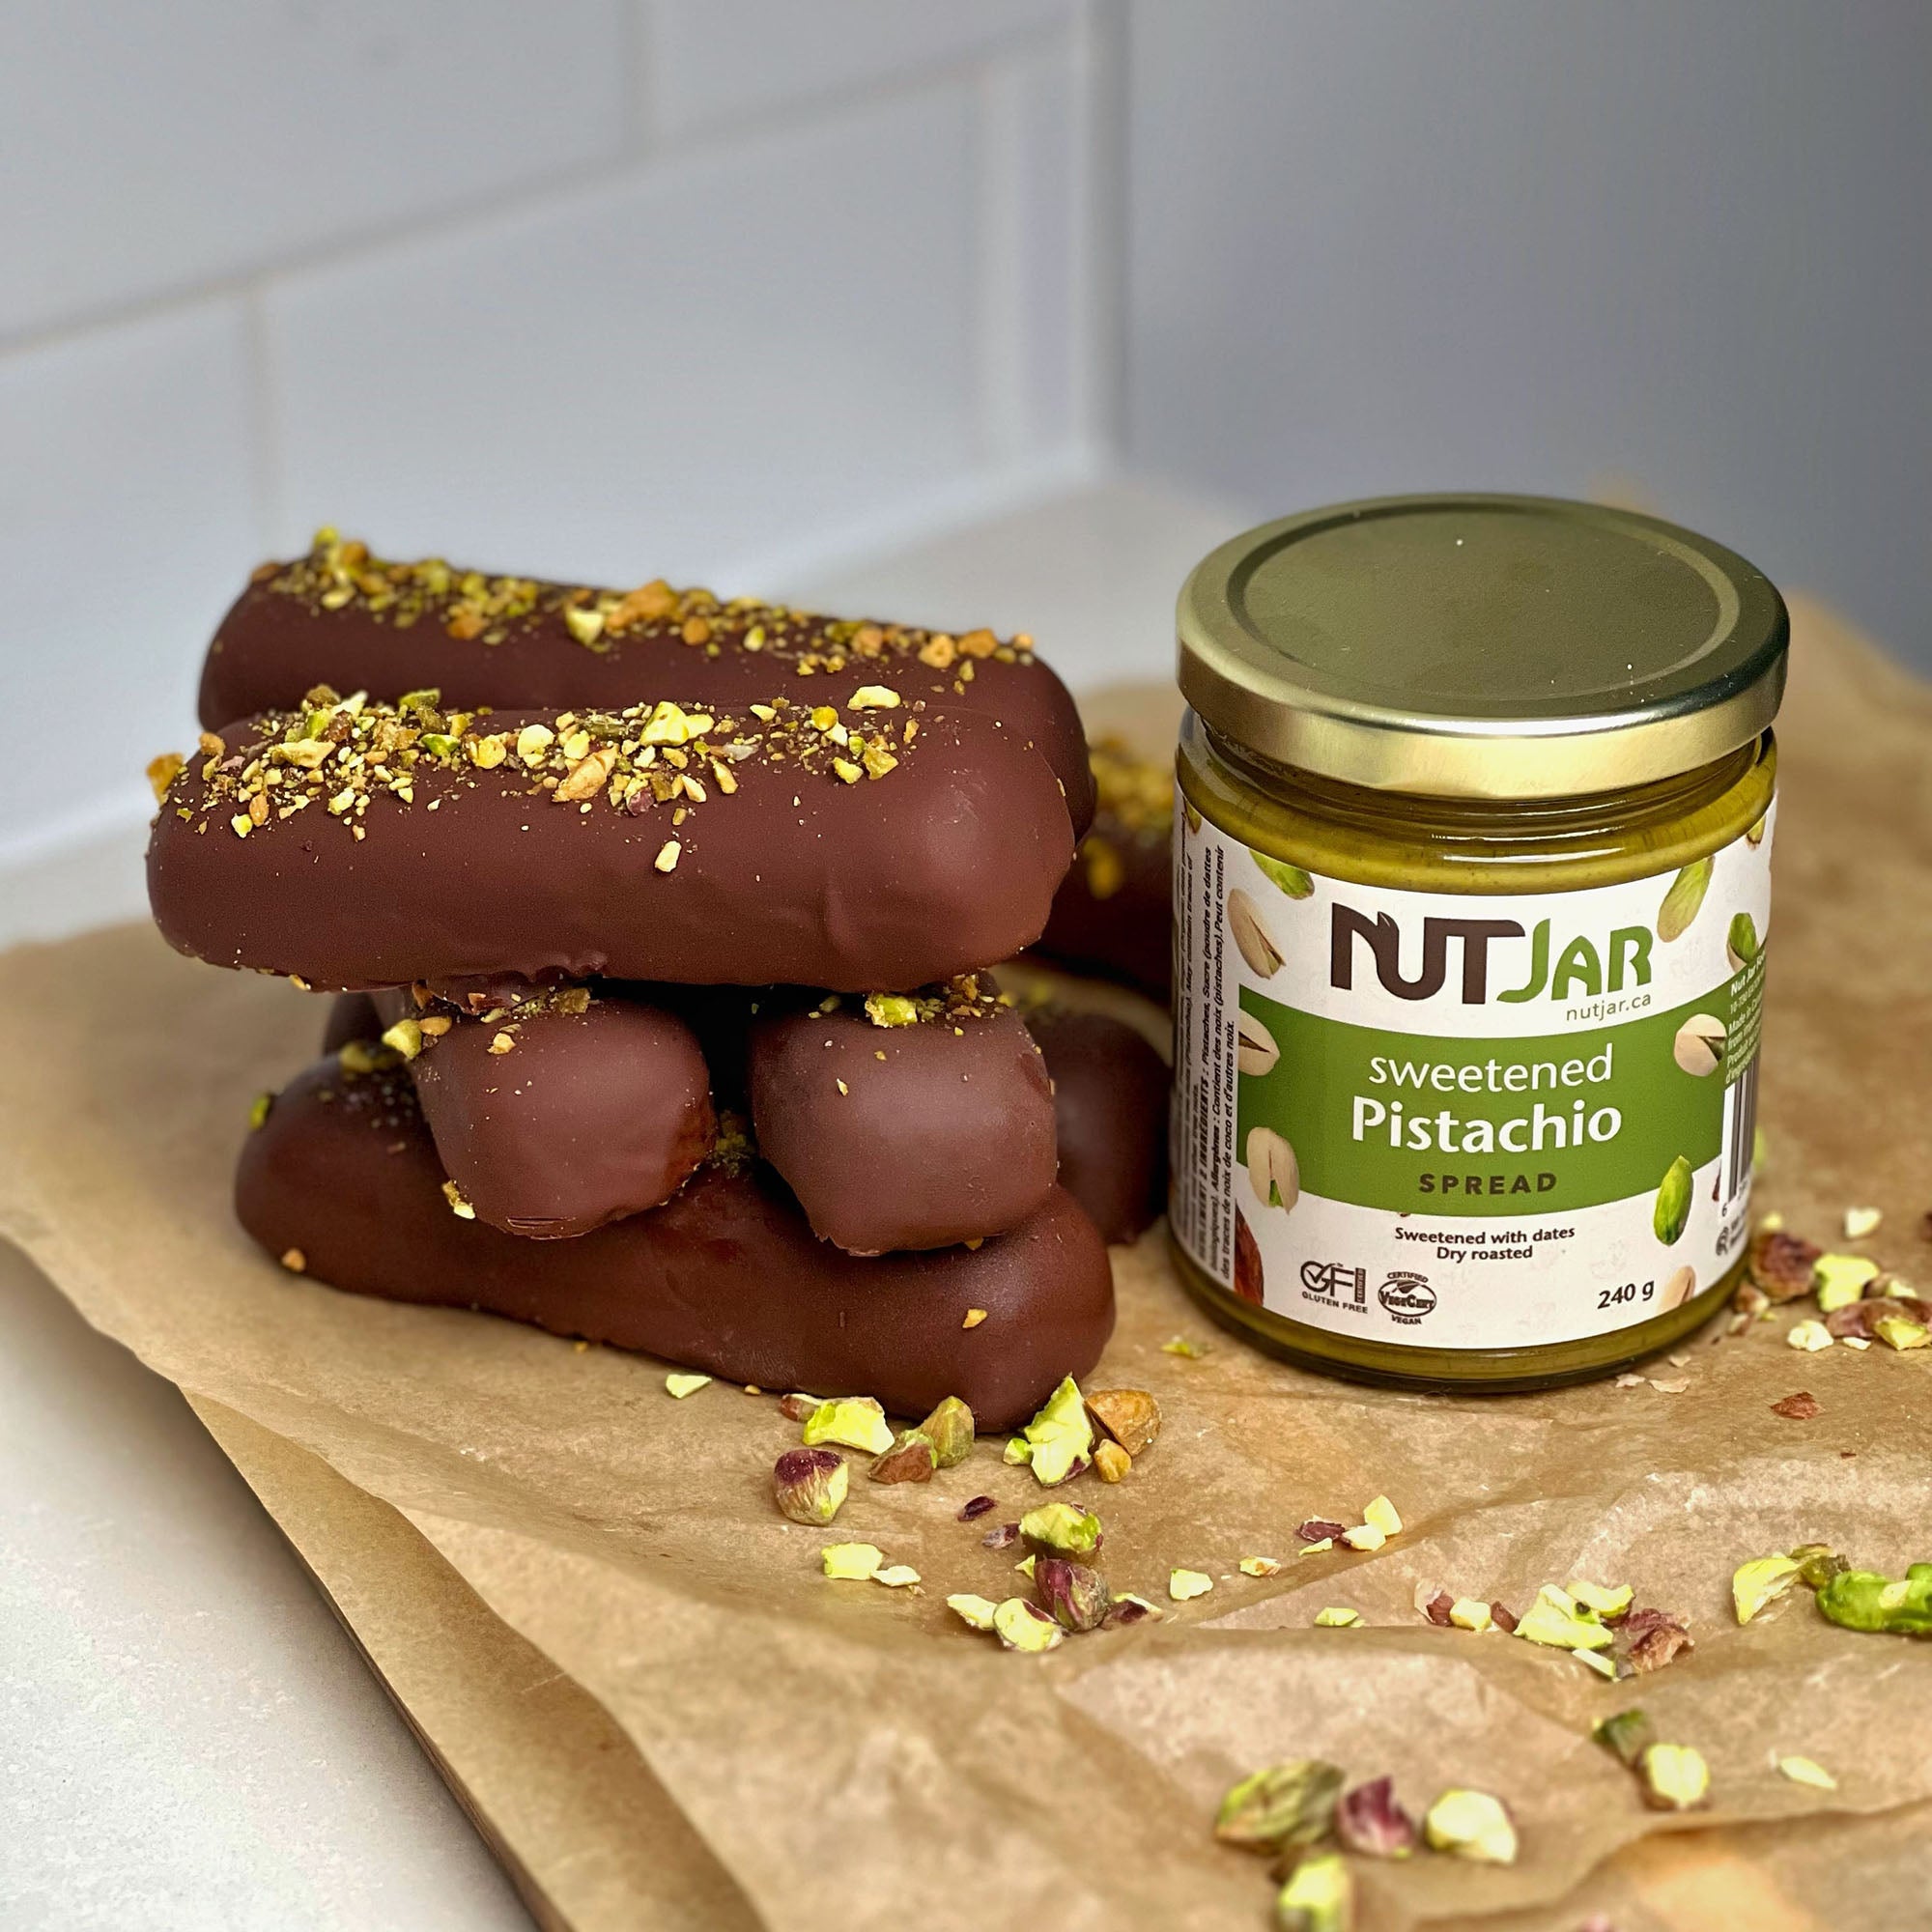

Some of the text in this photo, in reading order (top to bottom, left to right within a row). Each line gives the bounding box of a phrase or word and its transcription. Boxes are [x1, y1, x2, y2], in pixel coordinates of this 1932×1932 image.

[1185, 851, 1192, 870] of
[1215, 844, 1224, 899] contenir
[1204, 891, 1210, 907] de
[1202, 909, 1211, 959] (poudre
[1566, 993, 1652, 1022] nutjar.ca
[1202, 1002, 1210, 1065] Pistaches,
[1213, 1008, 1222, 1036] noix
[1224, 1021, 1234, 1050] noix.
[1224, 1051, 1233, 1102] d'autres
[1368, 1042, 1613, 1093] sweetened
[1212, 1063, 1221, 1116] Contient
[1199, 1076, 1208, 1168] INGRÉDIENTS
[1224, 1103, 1232, 1118] et
[1352, 1095, 1622, 1153] Pistachio
[1211, 1125, 1221, 1191] Allergènes
[1222, 1152, 1232, 1168] de
[1222, 1170, 1231, 1197] noix
[1419, 1173, 1557, 1195] SPREAD
[1222, 1199, 1230, 1215] de
[1221, 1217, 1230, 1255] traces
[1395, 1226, 1576, 1244] Sweetened with dates
[1221, 1258, 1230, 1279] des
[1436, 1245, 1533, 1264] Dry roasted
[1387, 1271, 1429, 1283] CERTIFIED
[1301, 1291, 1369, 1315] GLUTEN FREE
[1596, 1280, 1655, 1310] 240 g
[1391, 1314, 1423, 1325] VEGAN
